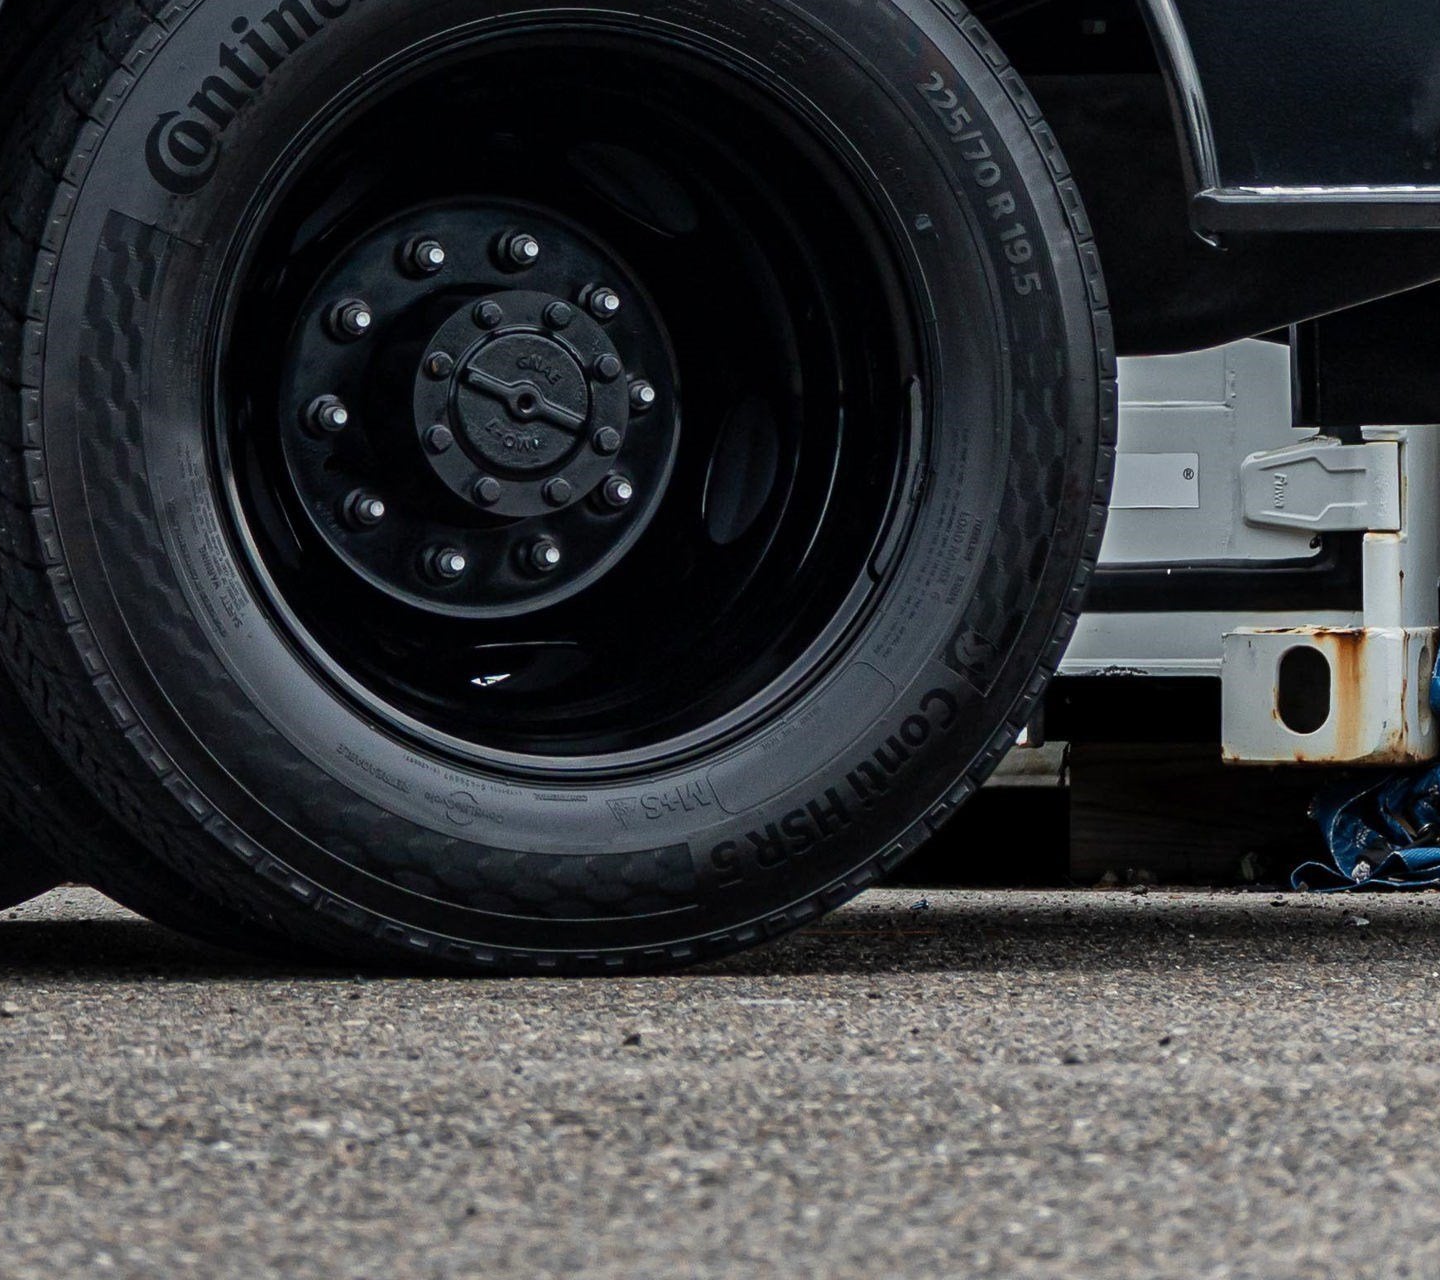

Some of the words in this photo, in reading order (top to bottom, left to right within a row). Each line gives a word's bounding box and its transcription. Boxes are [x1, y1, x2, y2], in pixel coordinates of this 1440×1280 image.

[915, 71, 1003, 192] 225/70
[986, 194, 1016, 220] R
[1000, 224, 1042, 297] 19.5
[843, 687, 959, 812] Conti
[746, 786, 854, 869] HSR
